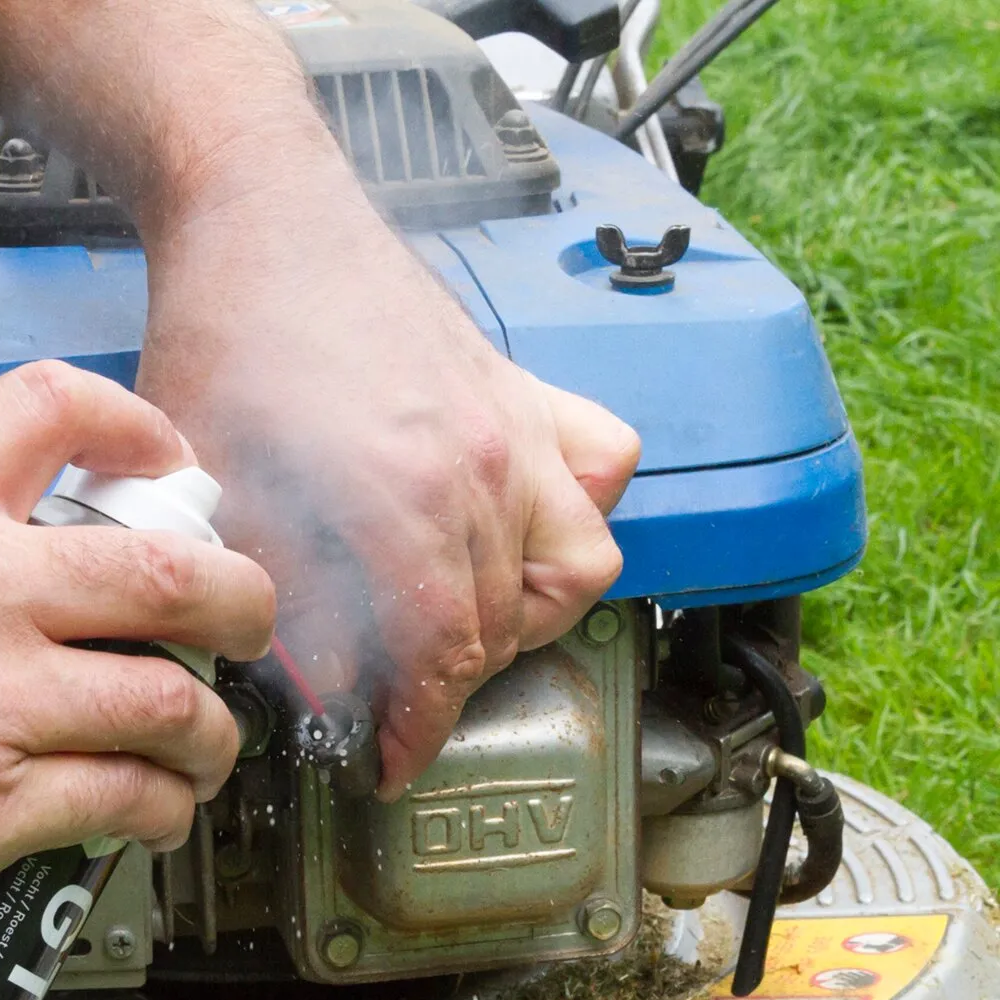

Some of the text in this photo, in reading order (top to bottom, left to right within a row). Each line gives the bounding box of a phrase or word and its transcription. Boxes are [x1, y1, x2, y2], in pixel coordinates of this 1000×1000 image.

[412, 796, 572, 856] OHV
[12, 857, 37, 892] Vocht
[25, 865, 52, 900] Vocht
[2, 911, 26, 948] Roest
